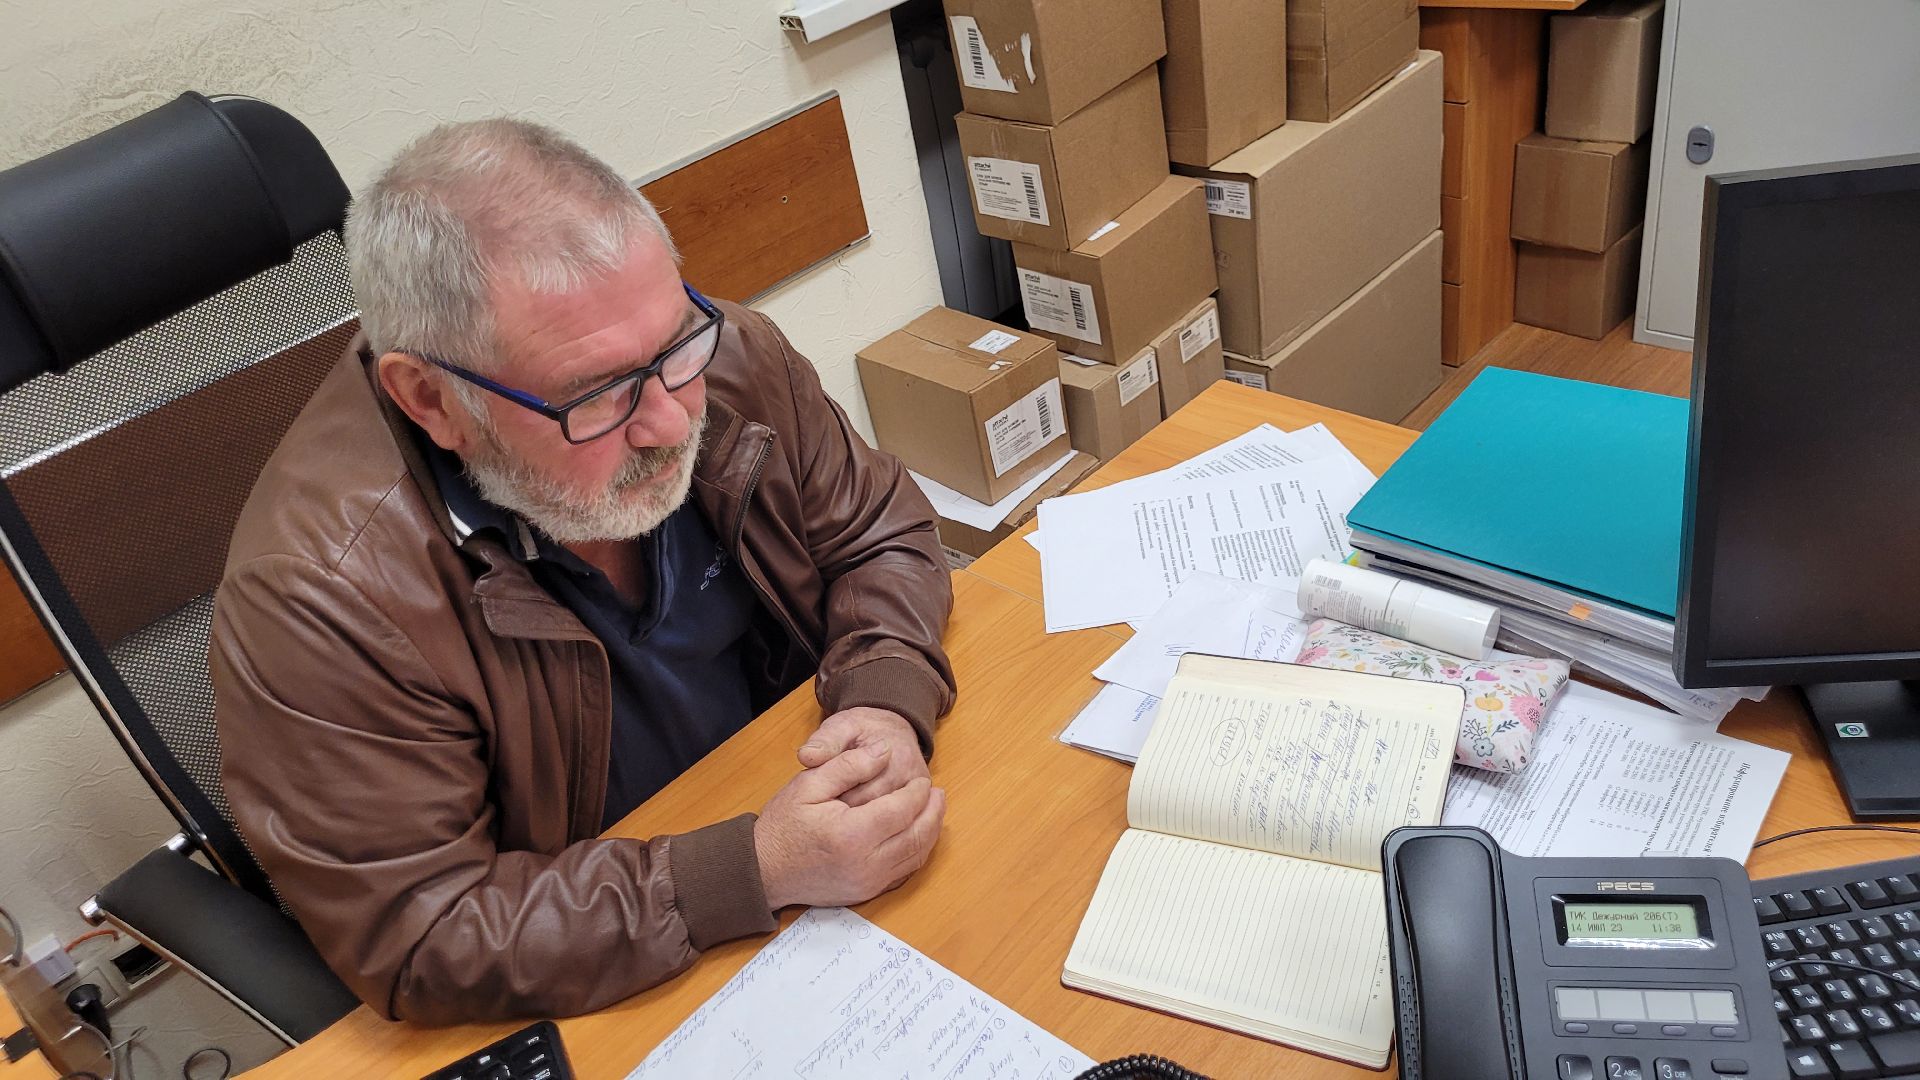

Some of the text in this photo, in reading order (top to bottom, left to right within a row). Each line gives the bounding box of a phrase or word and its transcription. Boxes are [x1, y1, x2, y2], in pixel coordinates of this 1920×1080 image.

[1597, 882, 1655, 891] iPECS
[1569, 911, 1586, 920] ТИК
[1592, 911, 1639, 921] Дежурный
[1571, 923, 1623, 933] 14 ИЮЛ 23
[1831, 951, 1842, 960] R
[1565, 1061, 1571, 1076] 1
[1611, 1063, 1622, 1077] 2
[1662, 1064, 1687, 1079] 3 DEF
